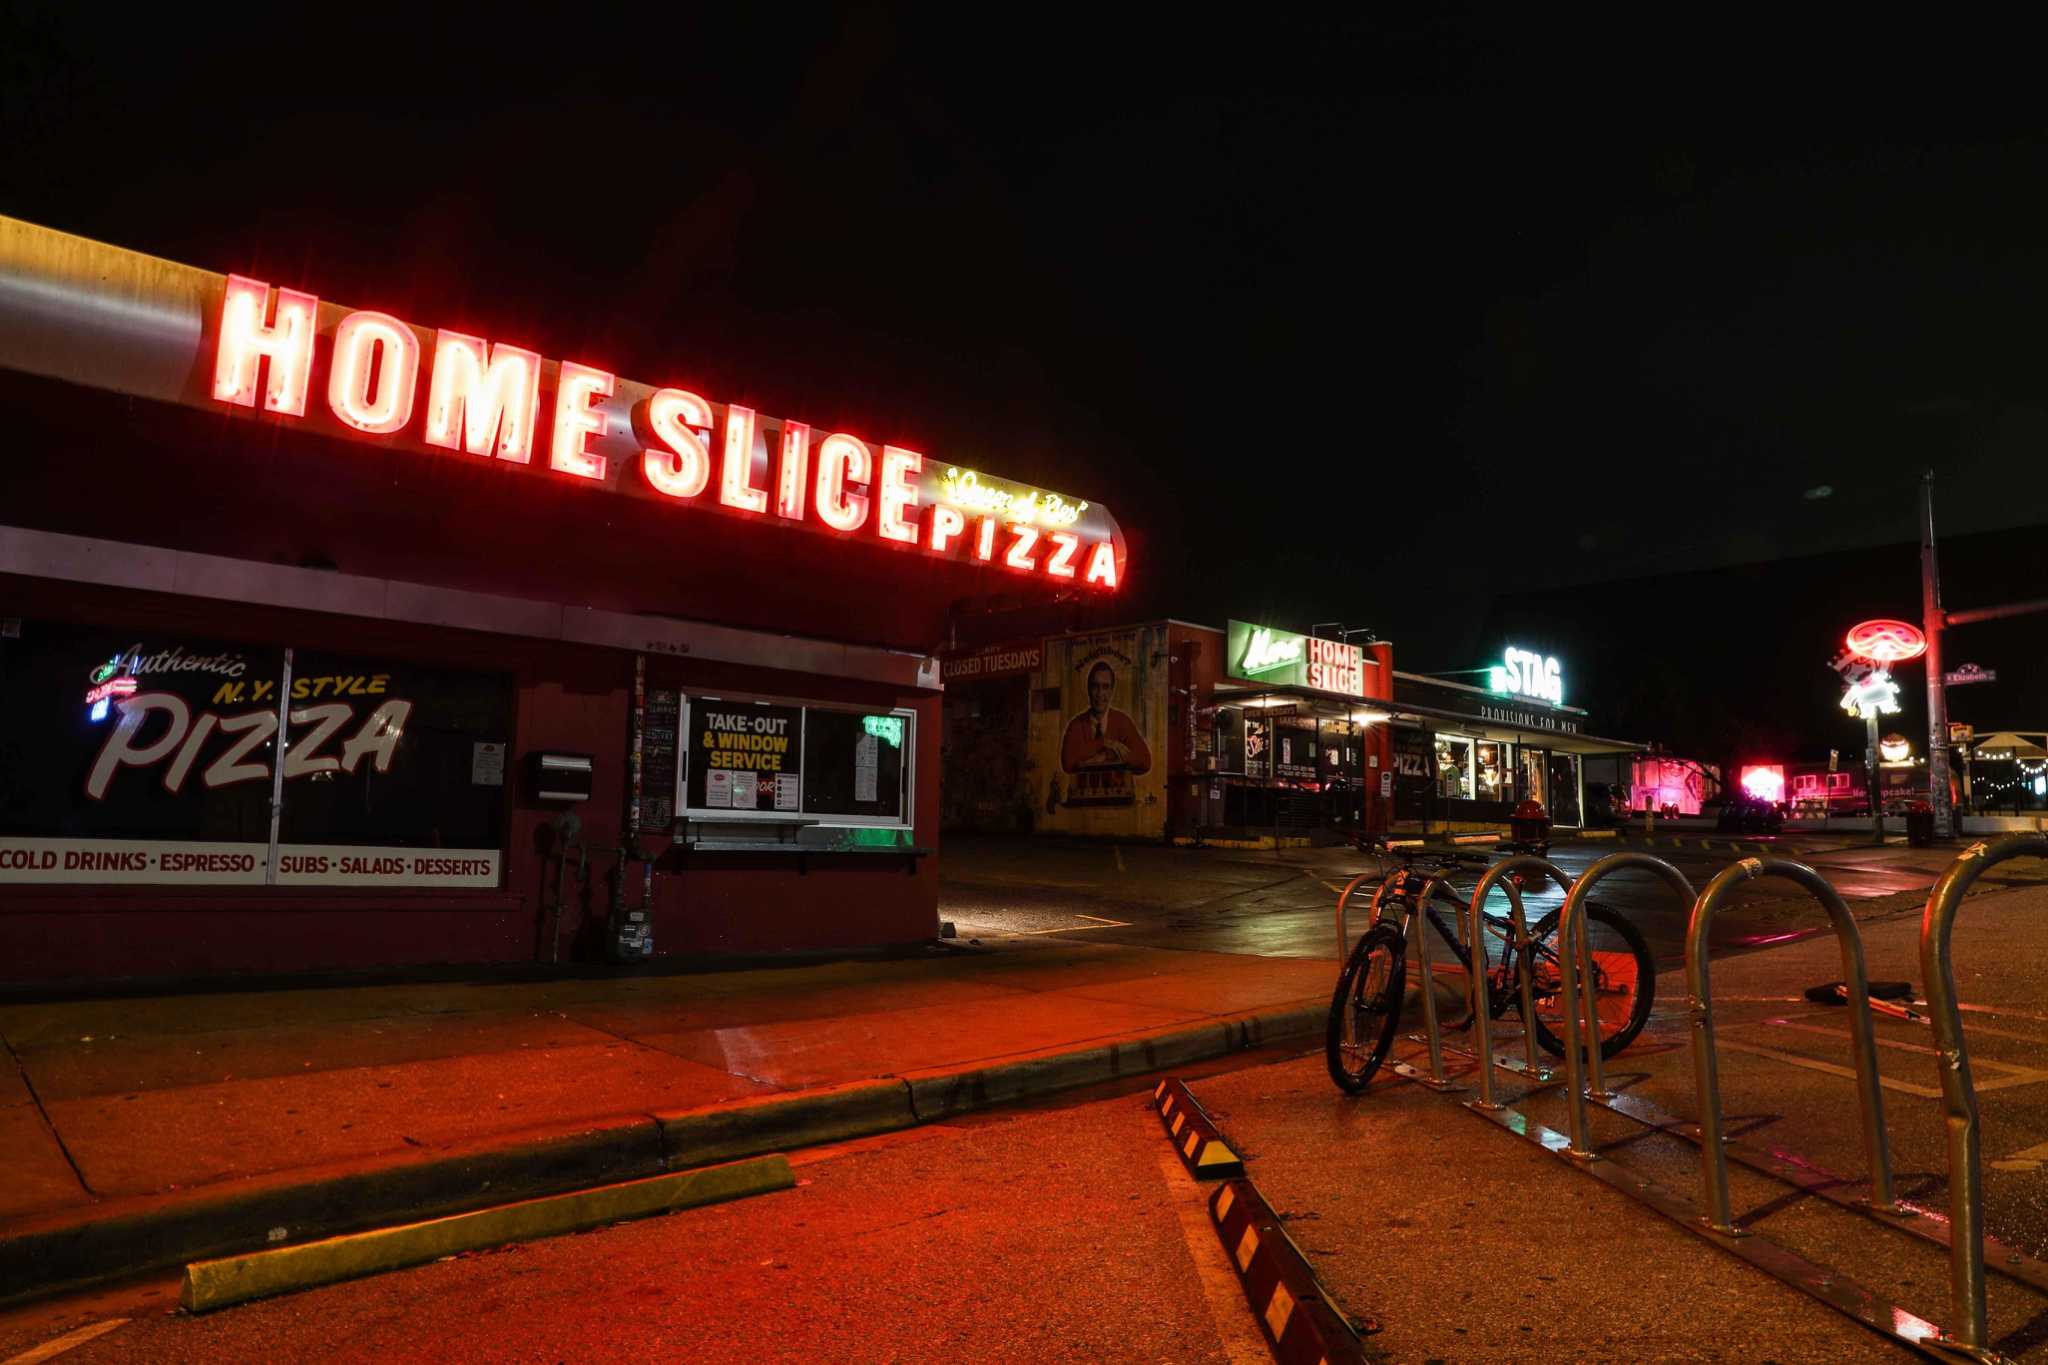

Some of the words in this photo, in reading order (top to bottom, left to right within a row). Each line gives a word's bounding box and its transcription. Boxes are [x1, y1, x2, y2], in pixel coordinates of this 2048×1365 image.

[211, 274, 615, 480] HOME
[643, 388, 923, 546] SLICE
[931, 503, 1117, 588] PIZZA
[89, 643, 248, 684] Authentic
[943, 658, 982, 678] CLOSED
[984, 649, 1040, 673] TUESDAYS
[1310, 638, 1361, 668] HOME
[211, 680, 274, 706] N.Y.
[290, 672, 391, 700] STYLE
[1310, 662, 1360, 694] SLICE
[1505, 647, 1563, 705] STAG
[705, 712, 788, 735] TAKE-OUT
[1480, 705, 1536, 728] PROVISIONS
[1539, 717, 1556, 730] FOR
[1561, 722, 1577, 734] MEN
[84, 689, 415, 801] PIZZA
[703, 730, 715, 749] &
[718, 732, 789, 754] WINDOW
[709, 750, 783, 773] SERVICE
[0, 849, 57, 870] COLD
[64, 851, 147, 871] DRINKS
[160, 853, 254, 873] ESPRESSO
[280, 855, 329, 874] SUBS
[339, 855, 404, 875] SALADS
[414, 856, 490, 876] DESSERTS
